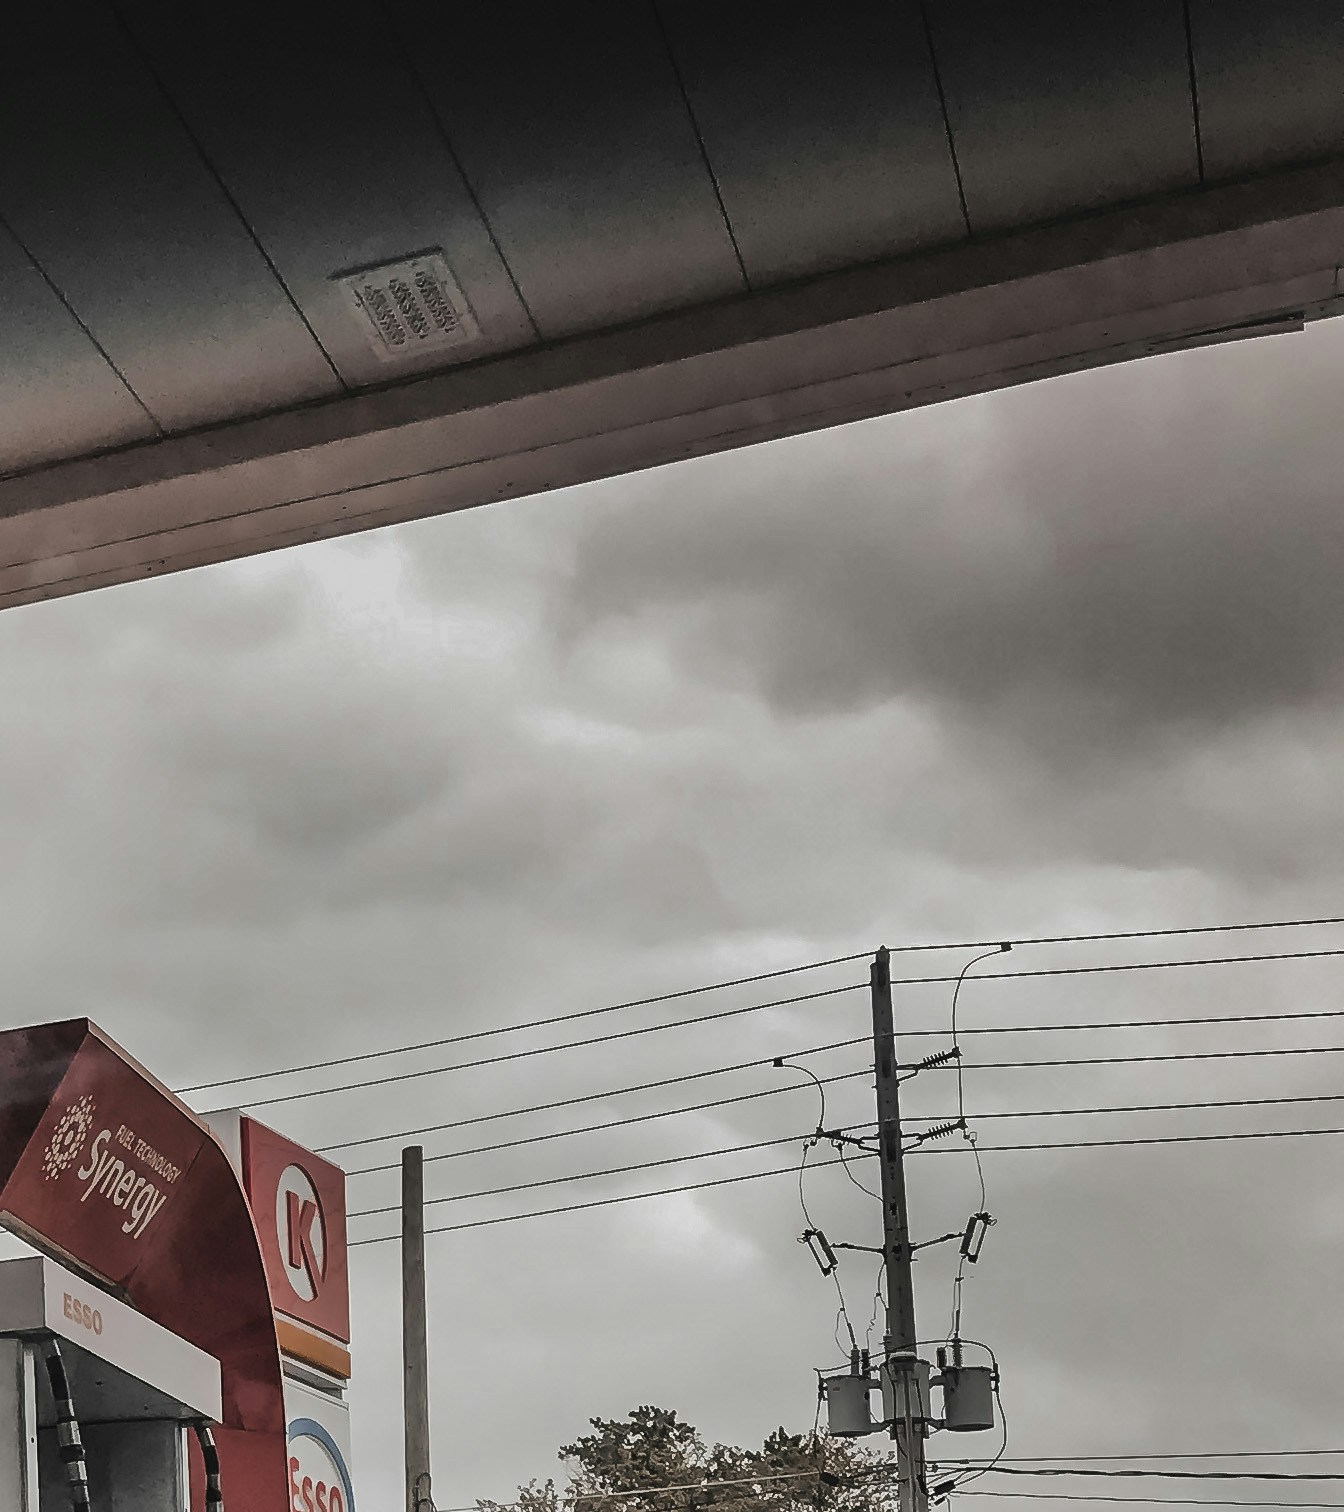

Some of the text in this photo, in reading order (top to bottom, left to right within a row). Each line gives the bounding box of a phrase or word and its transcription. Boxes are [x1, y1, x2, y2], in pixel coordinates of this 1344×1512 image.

[78, 1129, 168, 1240] Synergy
[115, 1124, 182, 1185] FUEL TECHNOLOGY
[63, 1292, 103, 1336] ESSO
